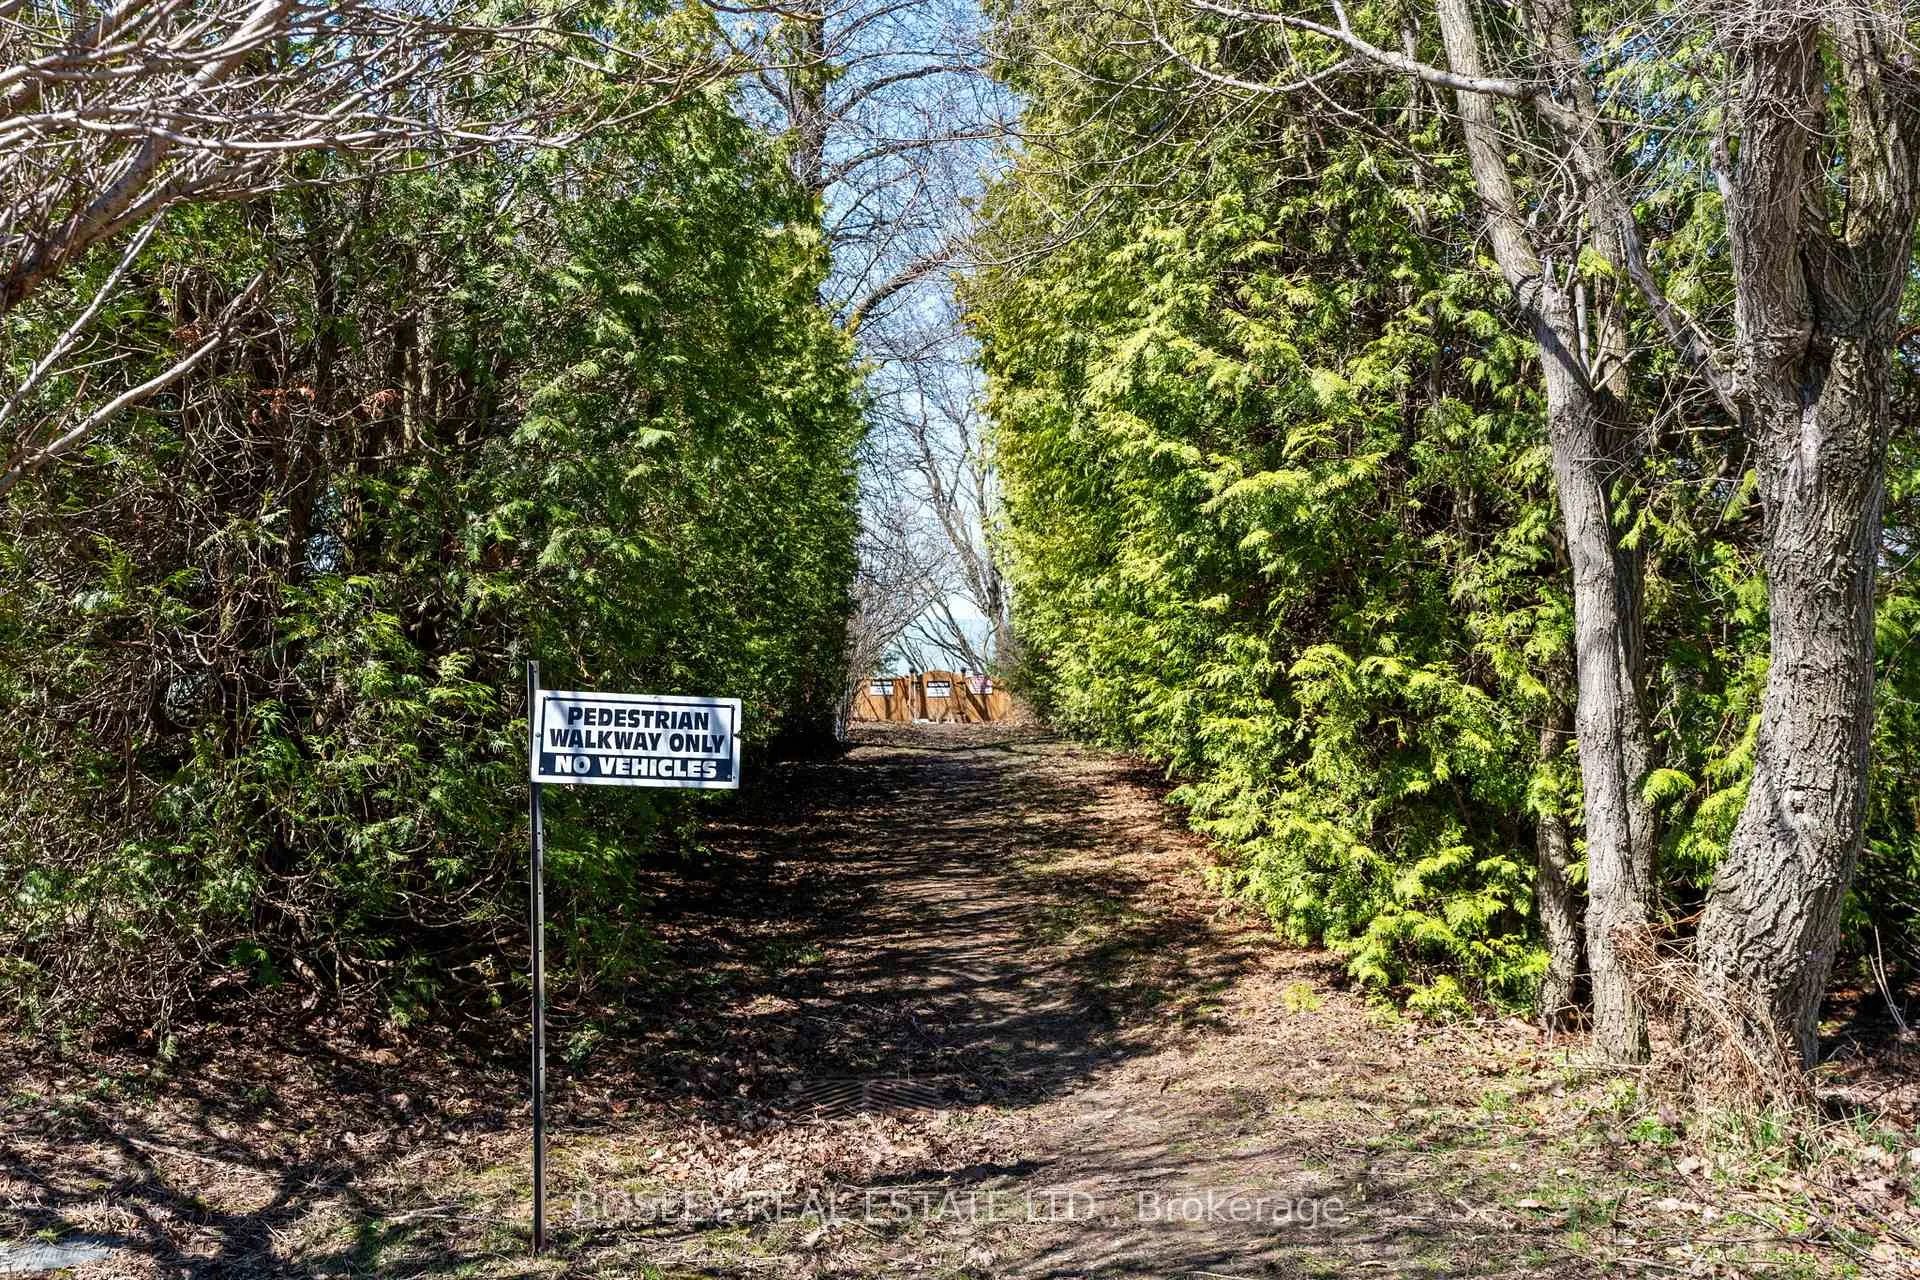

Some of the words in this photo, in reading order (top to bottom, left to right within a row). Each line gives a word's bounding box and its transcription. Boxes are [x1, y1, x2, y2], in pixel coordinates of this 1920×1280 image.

[567, 706, 709, 731] PEDESTRIAN
[549, 728, 662, 751] WALKWAY
[669, 733, 725, 754] ONLY
[554, 755, 591, 775] NO
[599, 757, 717, 779] VEHICLES
